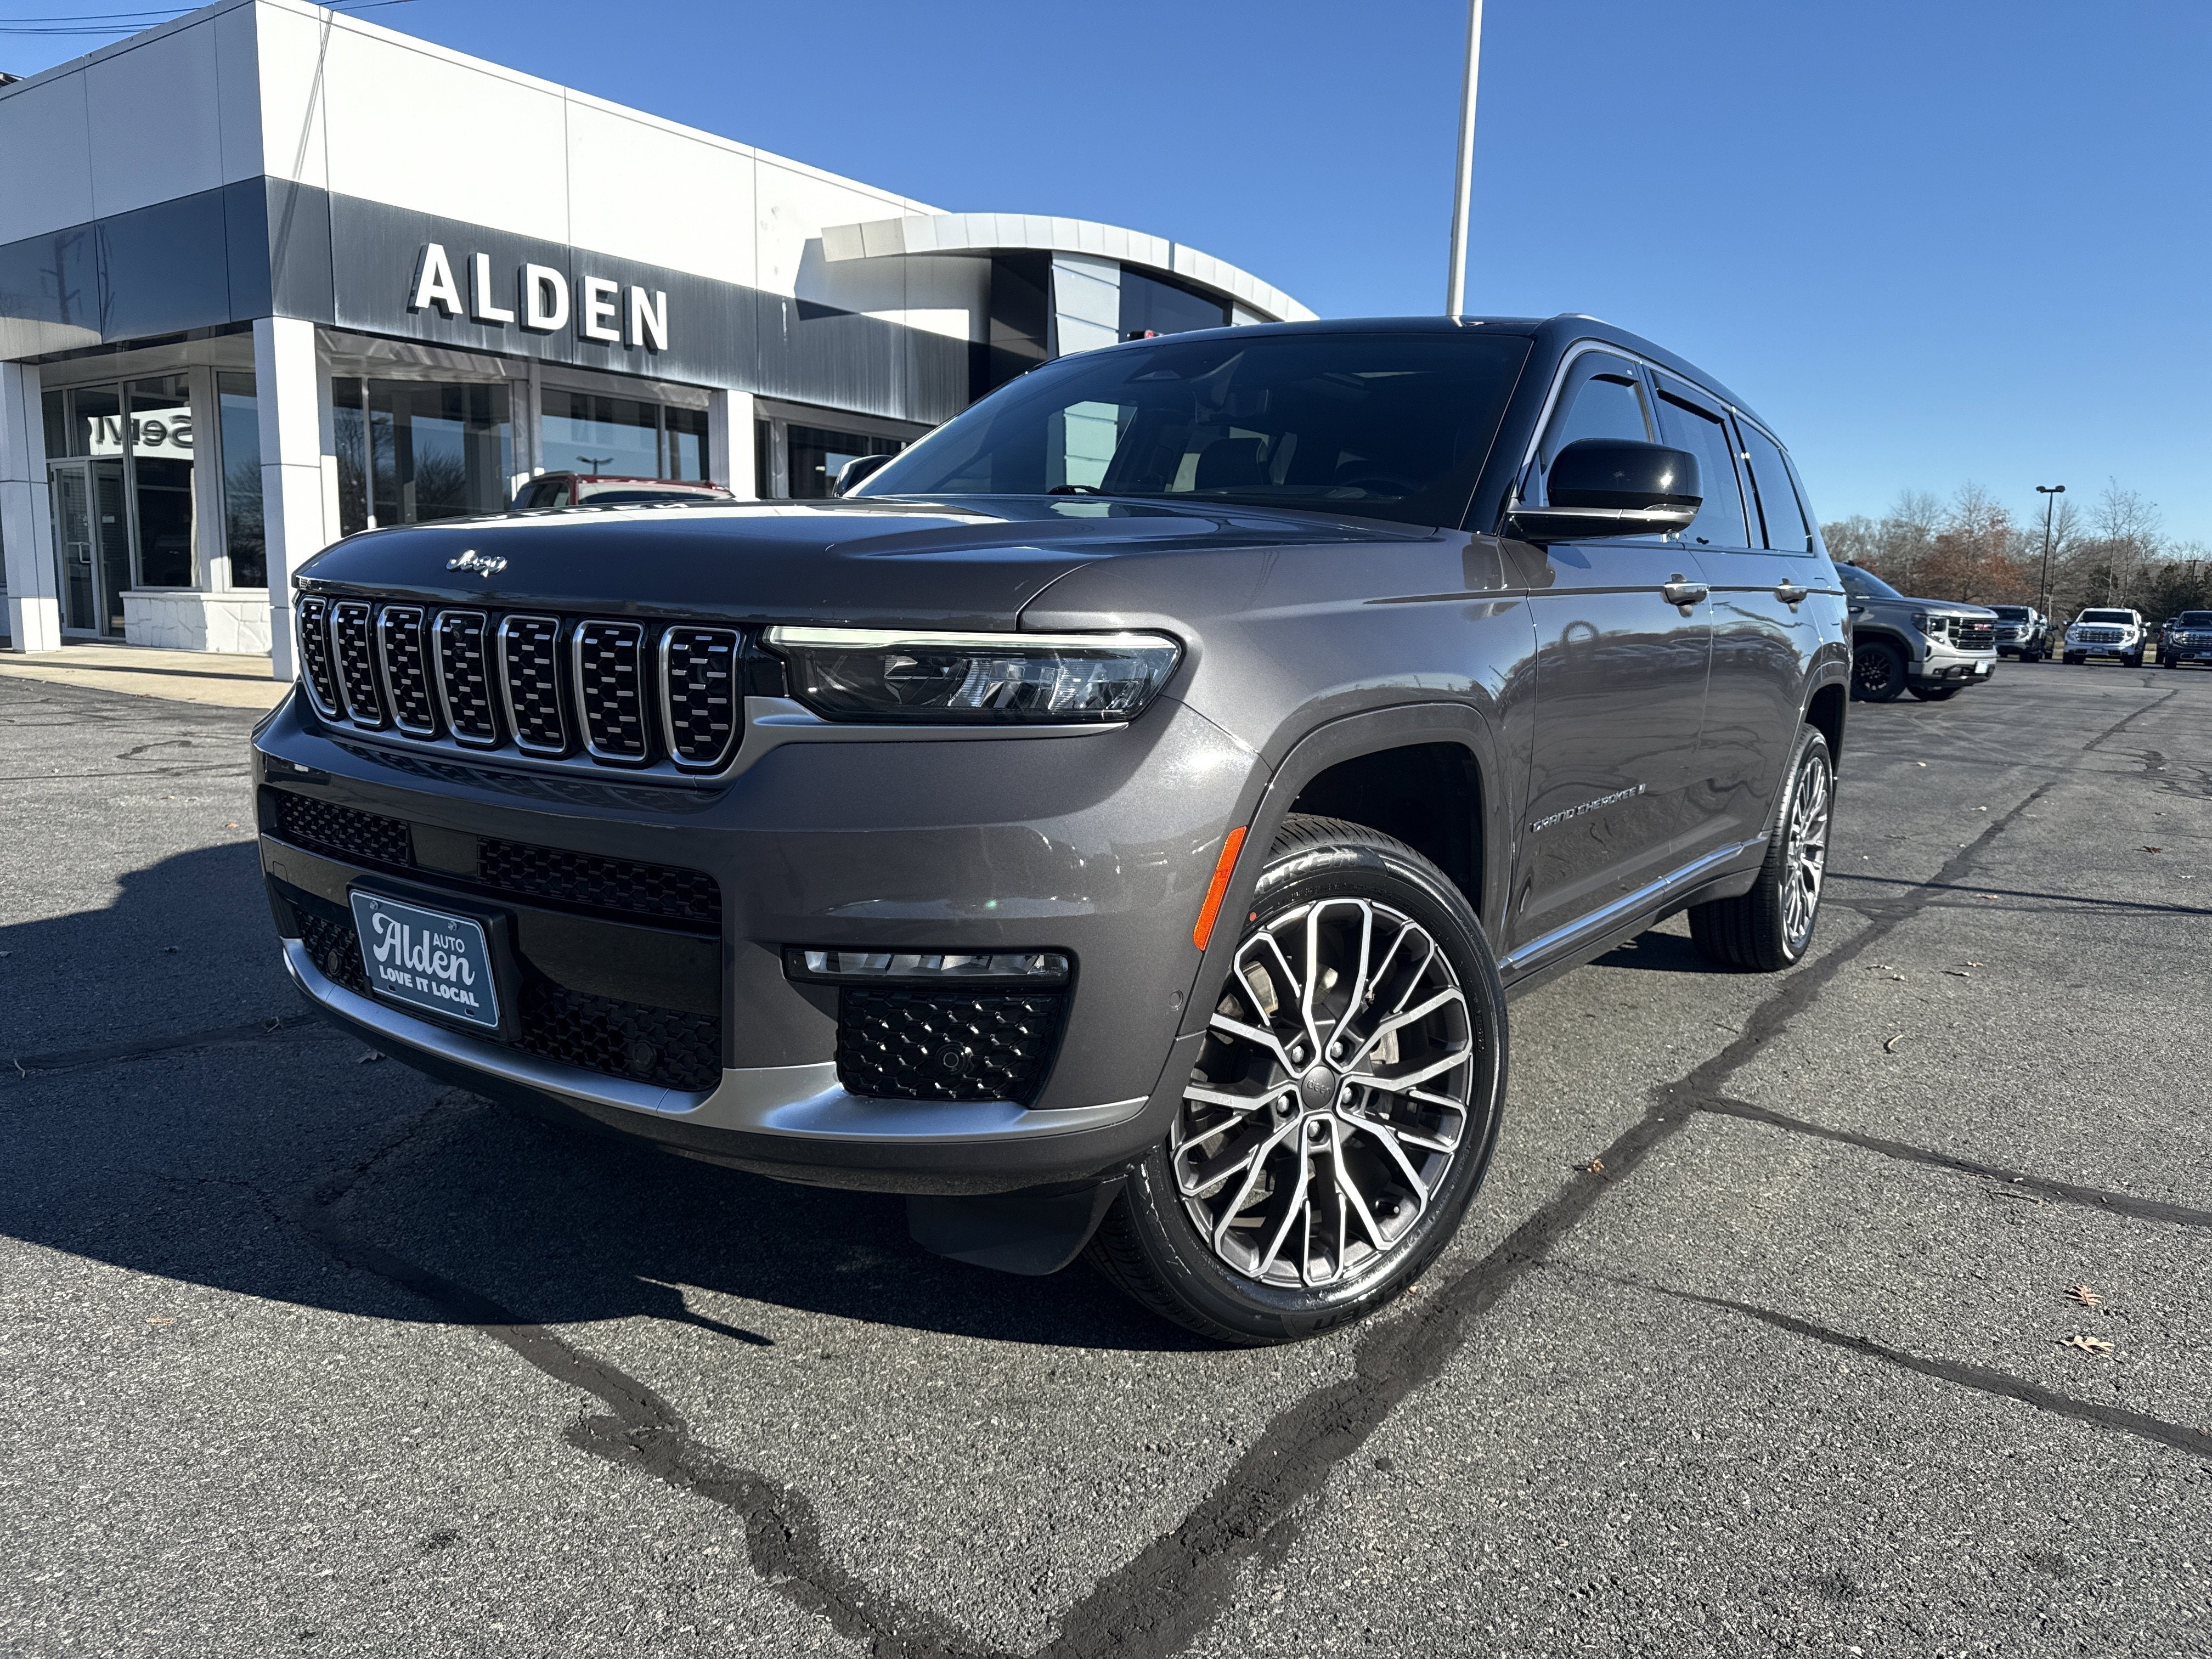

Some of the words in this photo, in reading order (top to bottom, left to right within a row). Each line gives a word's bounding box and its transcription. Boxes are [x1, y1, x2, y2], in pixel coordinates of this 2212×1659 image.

[407, 242, 668, 351] ALDEN
[446, 550, 508, 578] Jeep
[1531, 808, 1576, 833] GRAND
[1576, 786, 1637, 815] CHEROKEE
[372, 912, 476, 986] Alden
[433, 933, 465, 953] AUTO
[379, 964, 413, 988] LOVE
[415, 976, 429, 992] IT
[431, 981, 479, 1008] LOCAL
